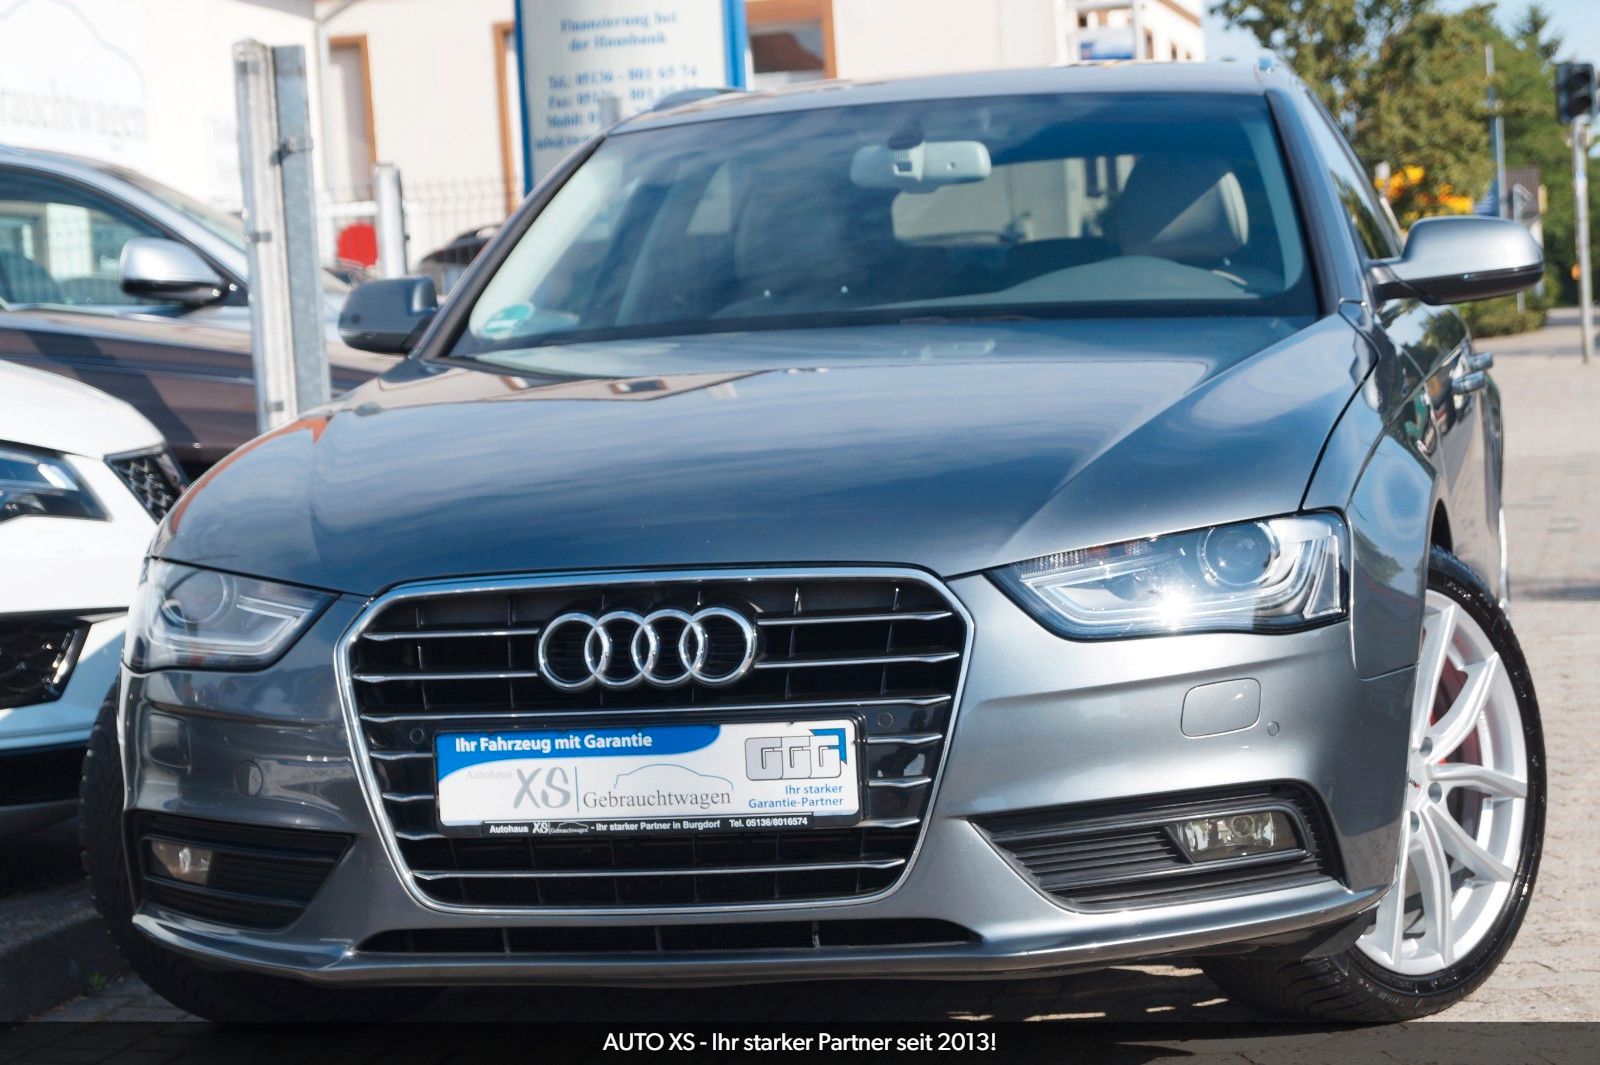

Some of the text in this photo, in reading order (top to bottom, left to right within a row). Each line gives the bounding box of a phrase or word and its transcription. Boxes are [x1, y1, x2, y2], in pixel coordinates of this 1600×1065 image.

[455, 732, 653, 753] Ihr Fahrzeug mit Garantie
[466, 766, 731, 810] Autohaus XS Gebrauchtwagen
[785, 784, 843, 795] Ihr starker
[748, 797, 843, 809] Garantie-Partner
[489, 824, 529, 834] Autohaus
[532, 821, 549, 834] XS
[596, 823, 607, 832] Ihr
[610, 822, 638, 831] starker
[640, 820, 670, 830] Partner
[673, 820, 680, 829] in
[683, 819, 720, 831] Burgdorf
[729, 818, 744, 828] Tel.
